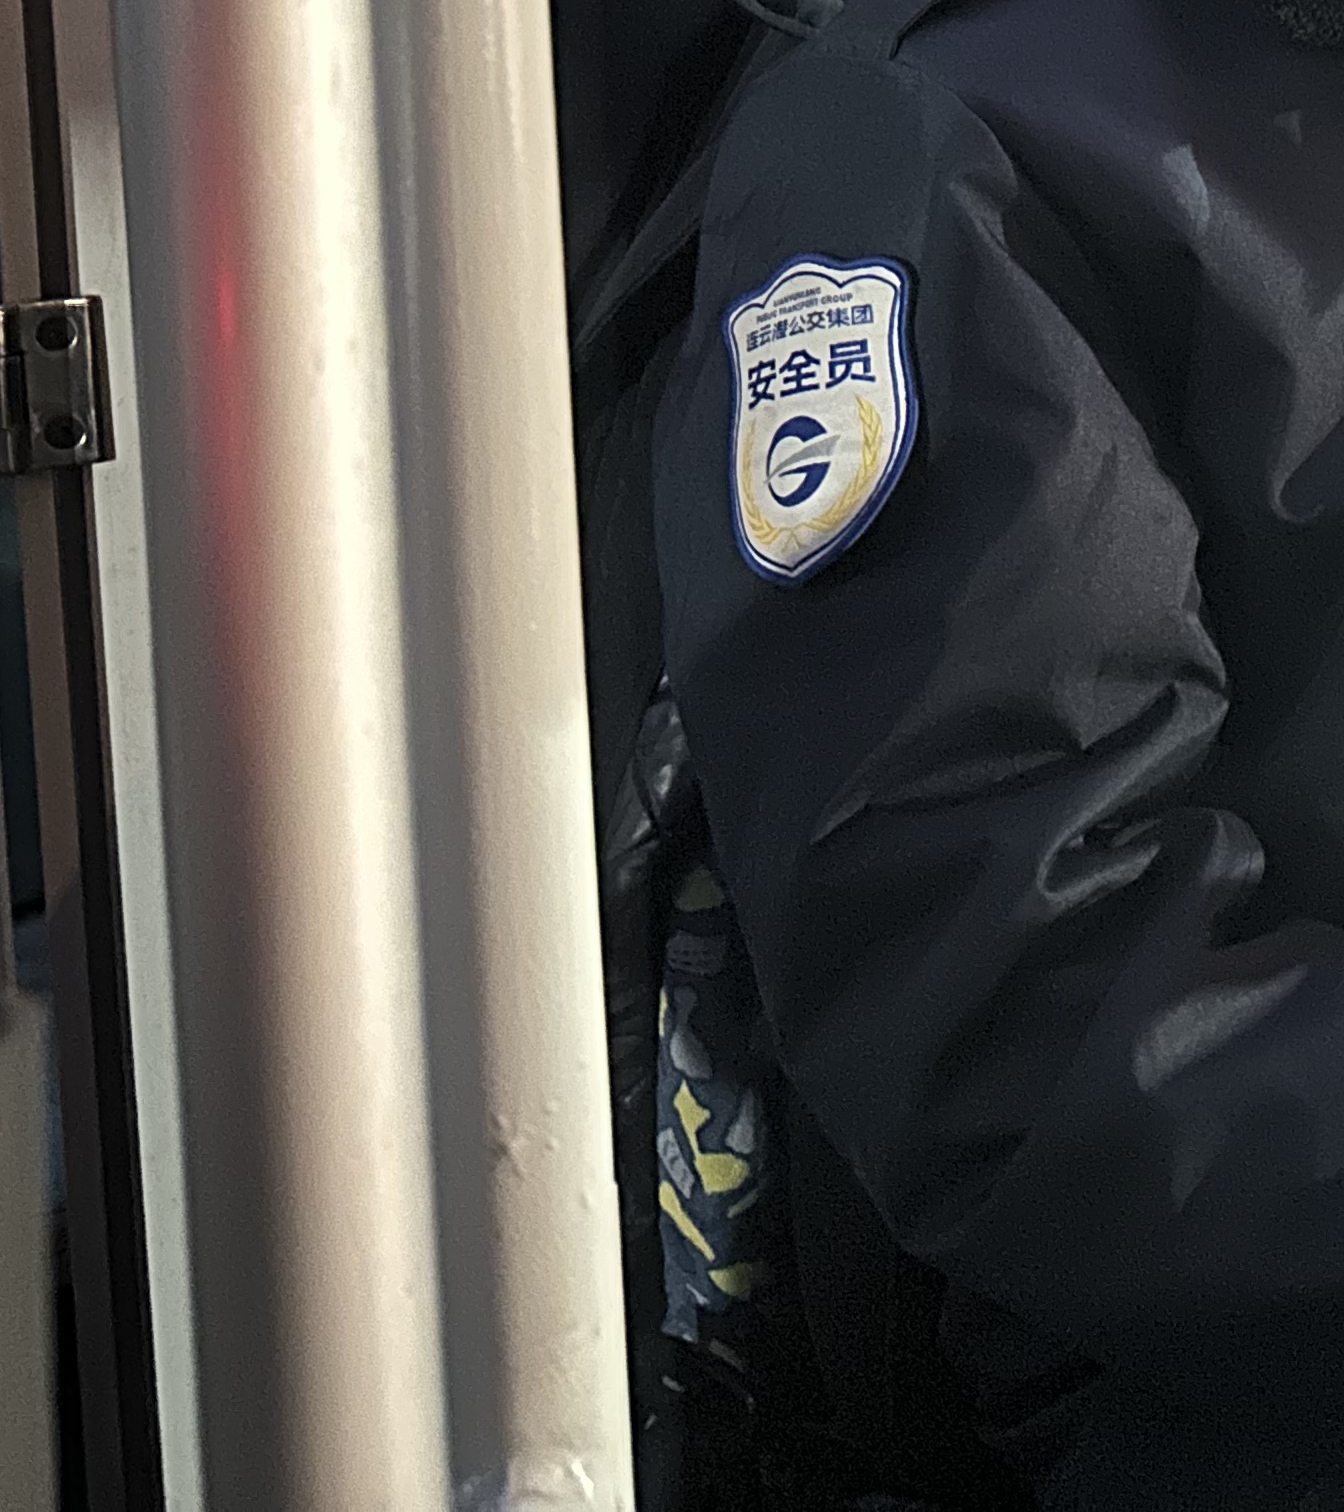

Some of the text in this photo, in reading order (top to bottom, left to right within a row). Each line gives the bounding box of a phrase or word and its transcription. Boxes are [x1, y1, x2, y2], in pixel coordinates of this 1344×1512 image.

[820, 292, 854, 306] GROUP
[746, 303, 874, 353] 连云港公交集团
[747, 338, 877, 411] 安全员
